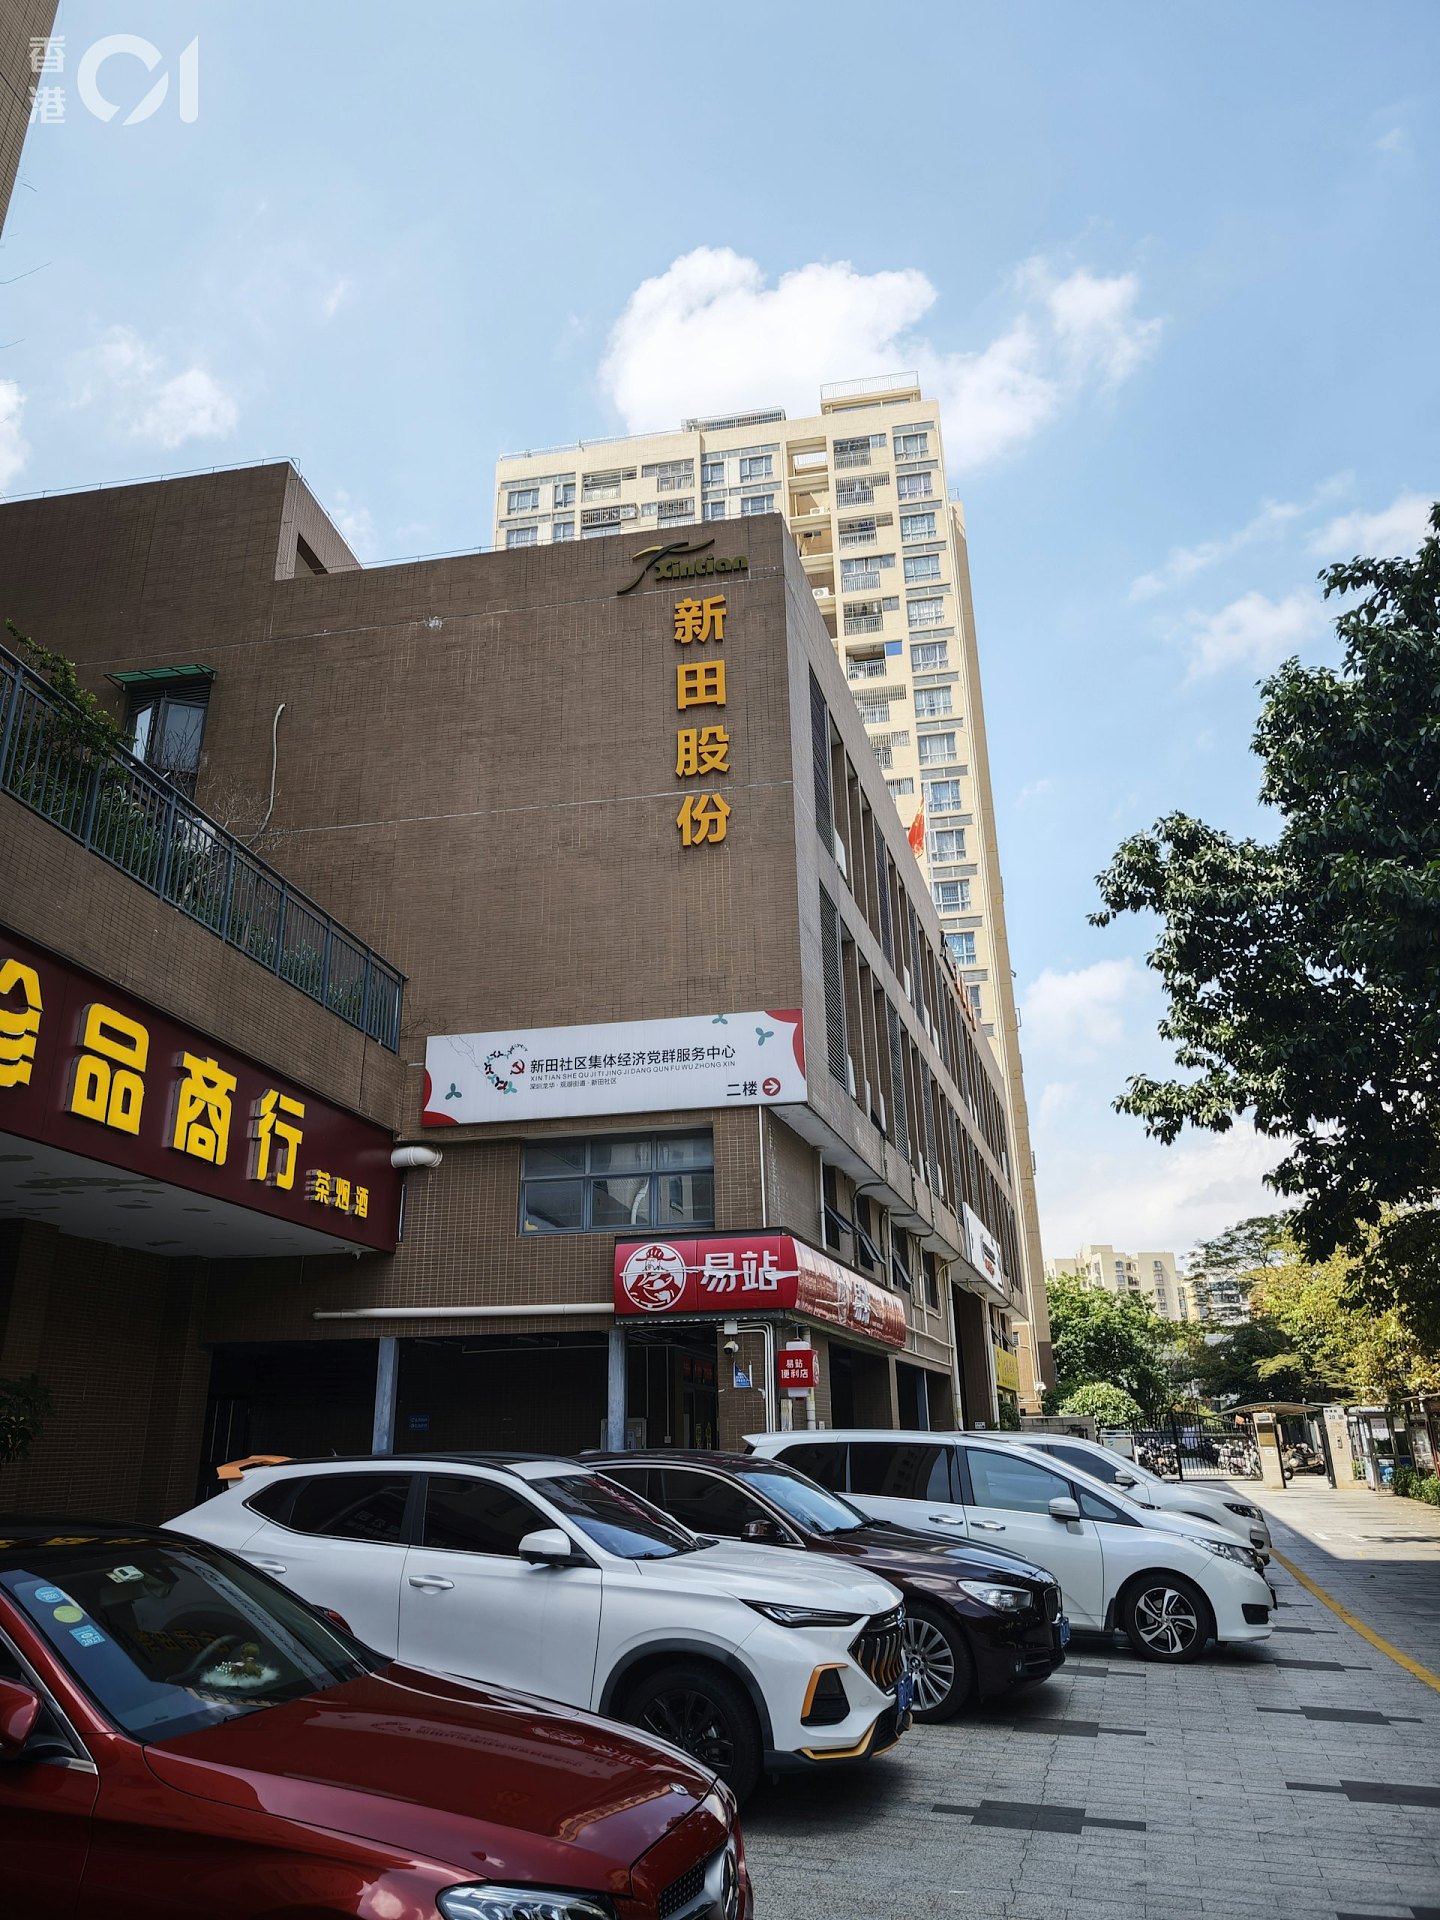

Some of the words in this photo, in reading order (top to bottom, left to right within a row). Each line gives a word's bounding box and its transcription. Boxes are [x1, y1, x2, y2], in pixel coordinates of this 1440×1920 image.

[673, 593, 731, 847] 新田股份
[530, 1044, 736, 1074] 新田社区集体经济党群服务中心
[653, 1065, 669, 1073] QUN
[694, 1061, 721, 1070] ZHONG
[726, 1081, 758, 1097] 二楼
[700, 1250, 779, 1293] 易站
[786, 1358, 803, 1369] 易站
[781, 1368, 809, 1379] 便利店
